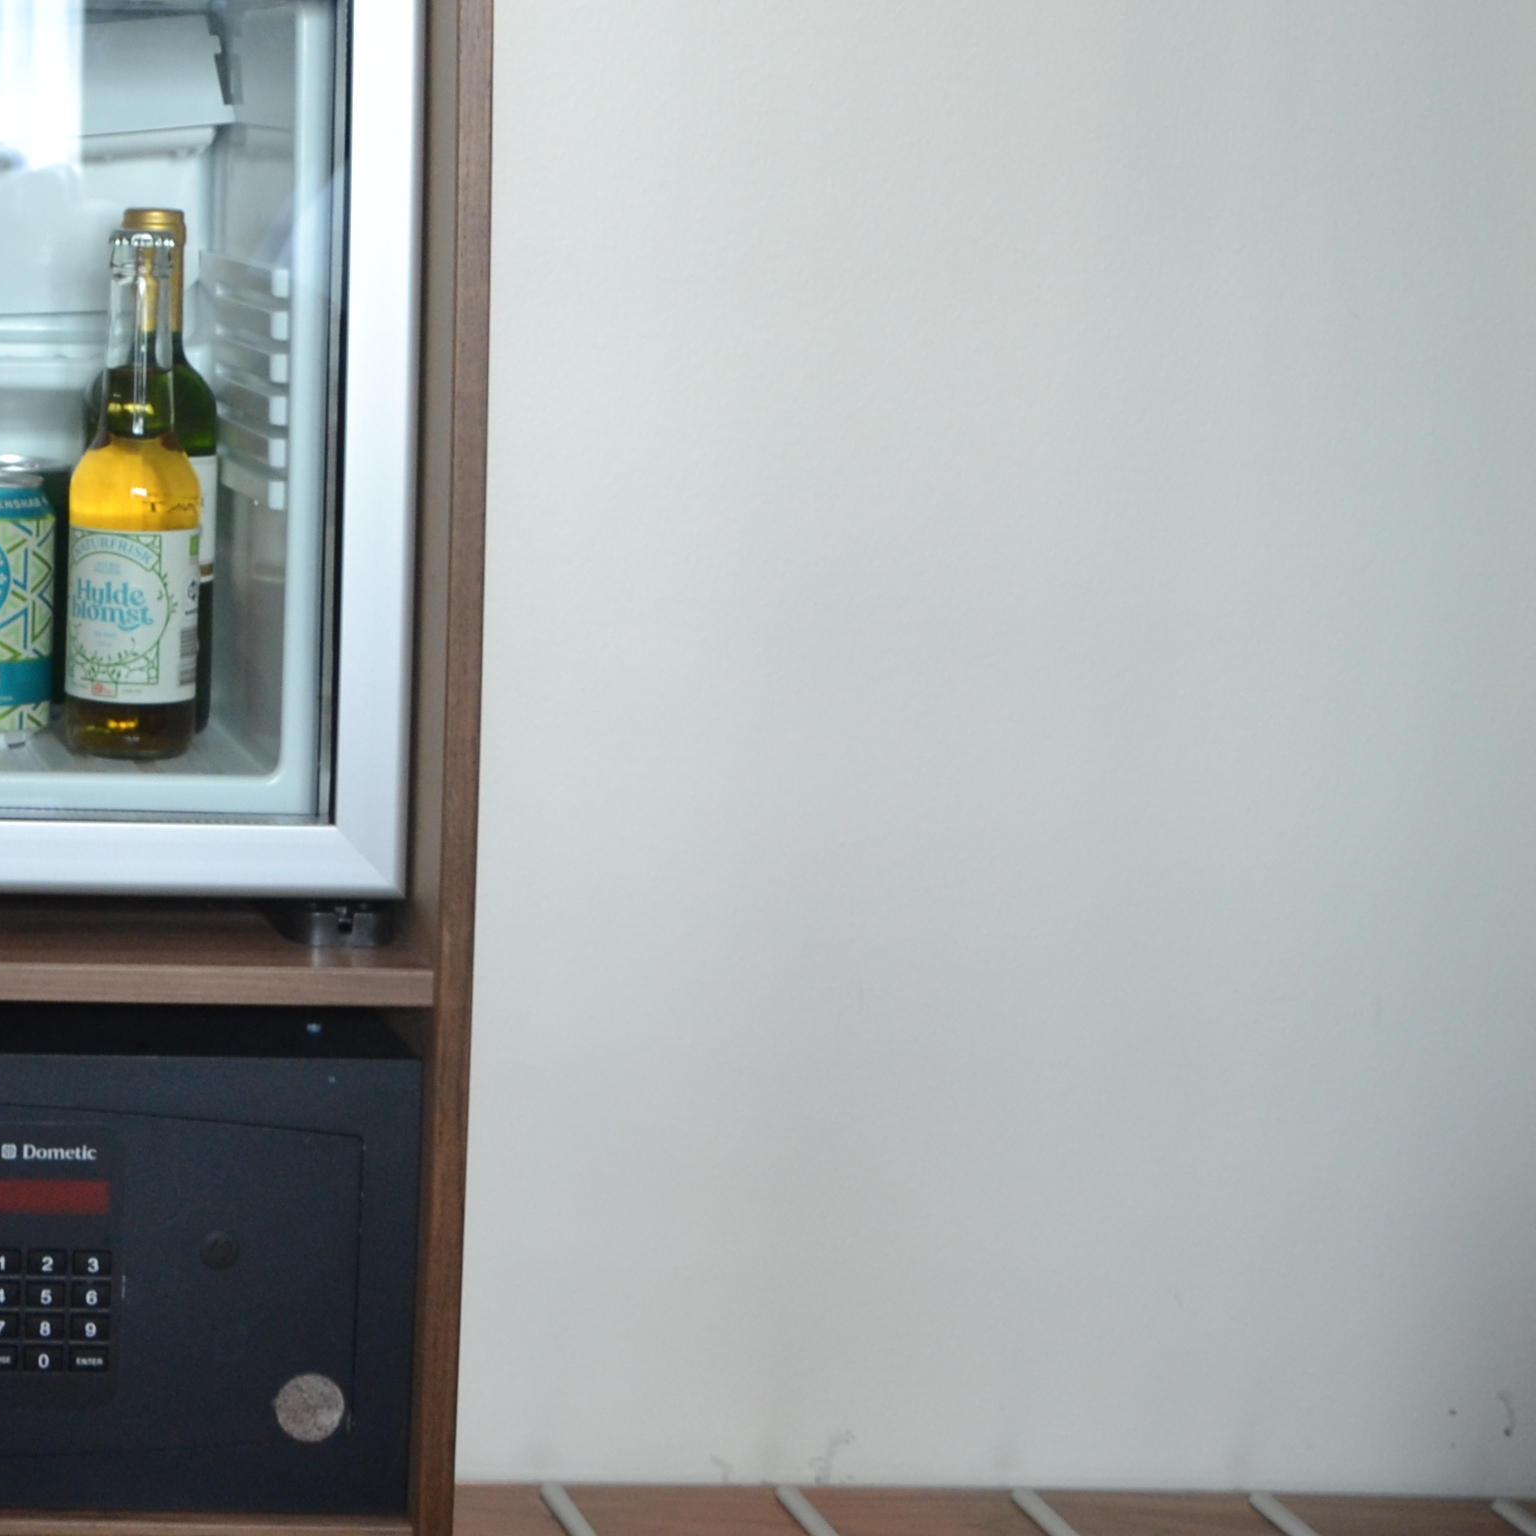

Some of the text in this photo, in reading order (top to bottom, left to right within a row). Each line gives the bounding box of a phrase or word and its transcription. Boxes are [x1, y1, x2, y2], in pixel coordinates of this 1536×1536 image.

[77, 577, 146, 607] Hylde
[72, 595, 154, 631] blomst
[23, 1143, 97, 1162] Dometic
[41, 1256, 54, 1272] 2
[87, 1257, 100, 1273] 3
[40, 1289, 52, 1305] 5
[85, 1289, 98, 1305] 6
[39, 1321, 51, 1337] 8
[84, 1321, 97, 1338] 9
[37, 1354, 50, 1369] 0
